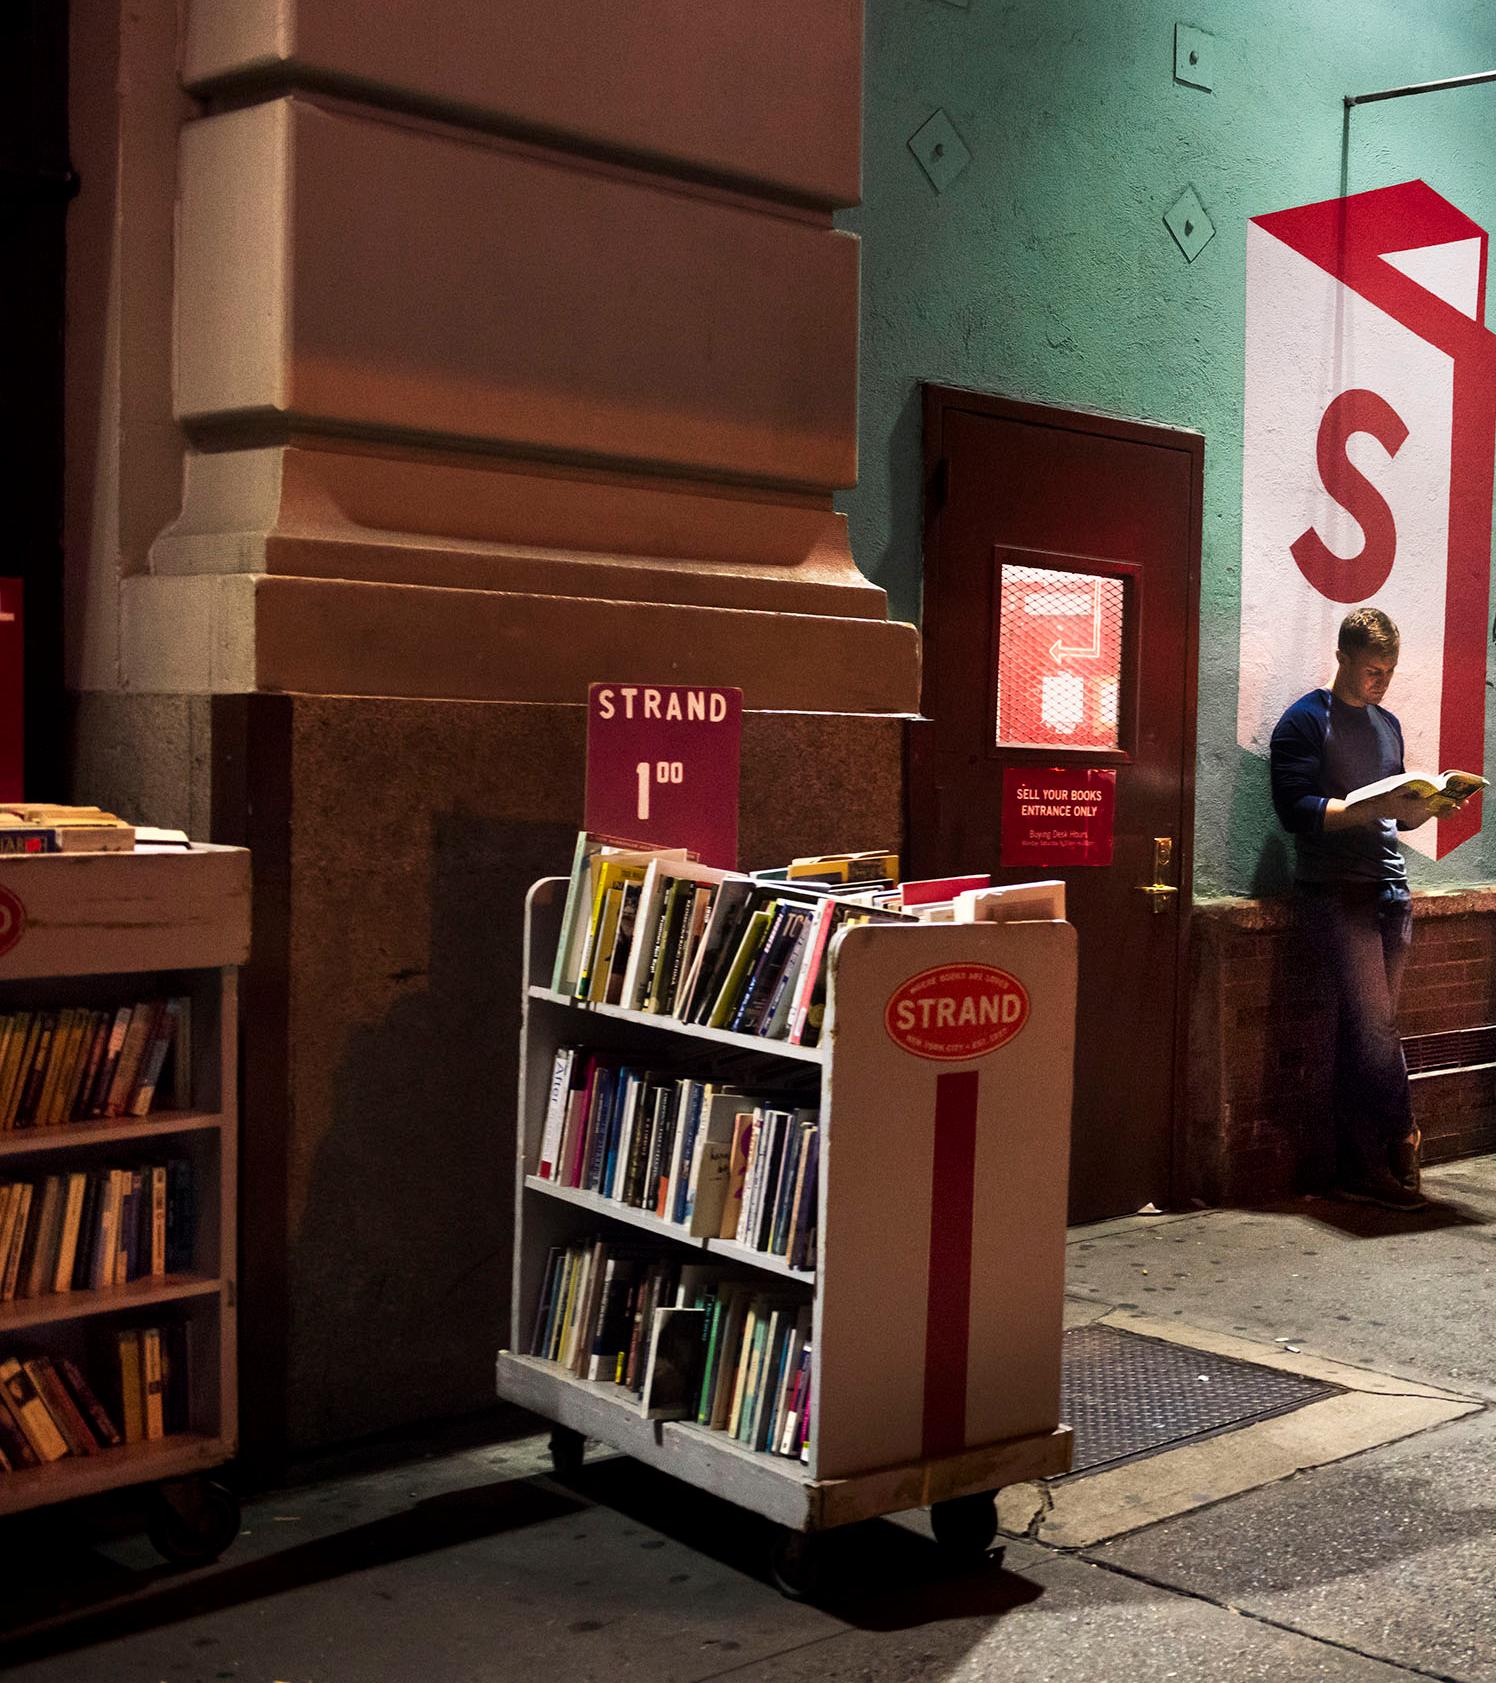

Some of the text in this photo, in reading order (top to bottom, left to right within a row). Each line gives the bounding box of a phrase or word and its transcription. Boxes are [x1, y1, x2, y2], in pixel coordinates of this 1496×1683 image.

[1289, 388, 1410, 604] S
[599, 688, 727, 722] STRAND
[1016, 788, 1102, 801] SELL YOUR BOOKS
[1021, 804, 1098, 816] ENTRANCE ONLY
[896, 994, 1021, 1030] STRAND
[551, 1061, 565, 1103] After
